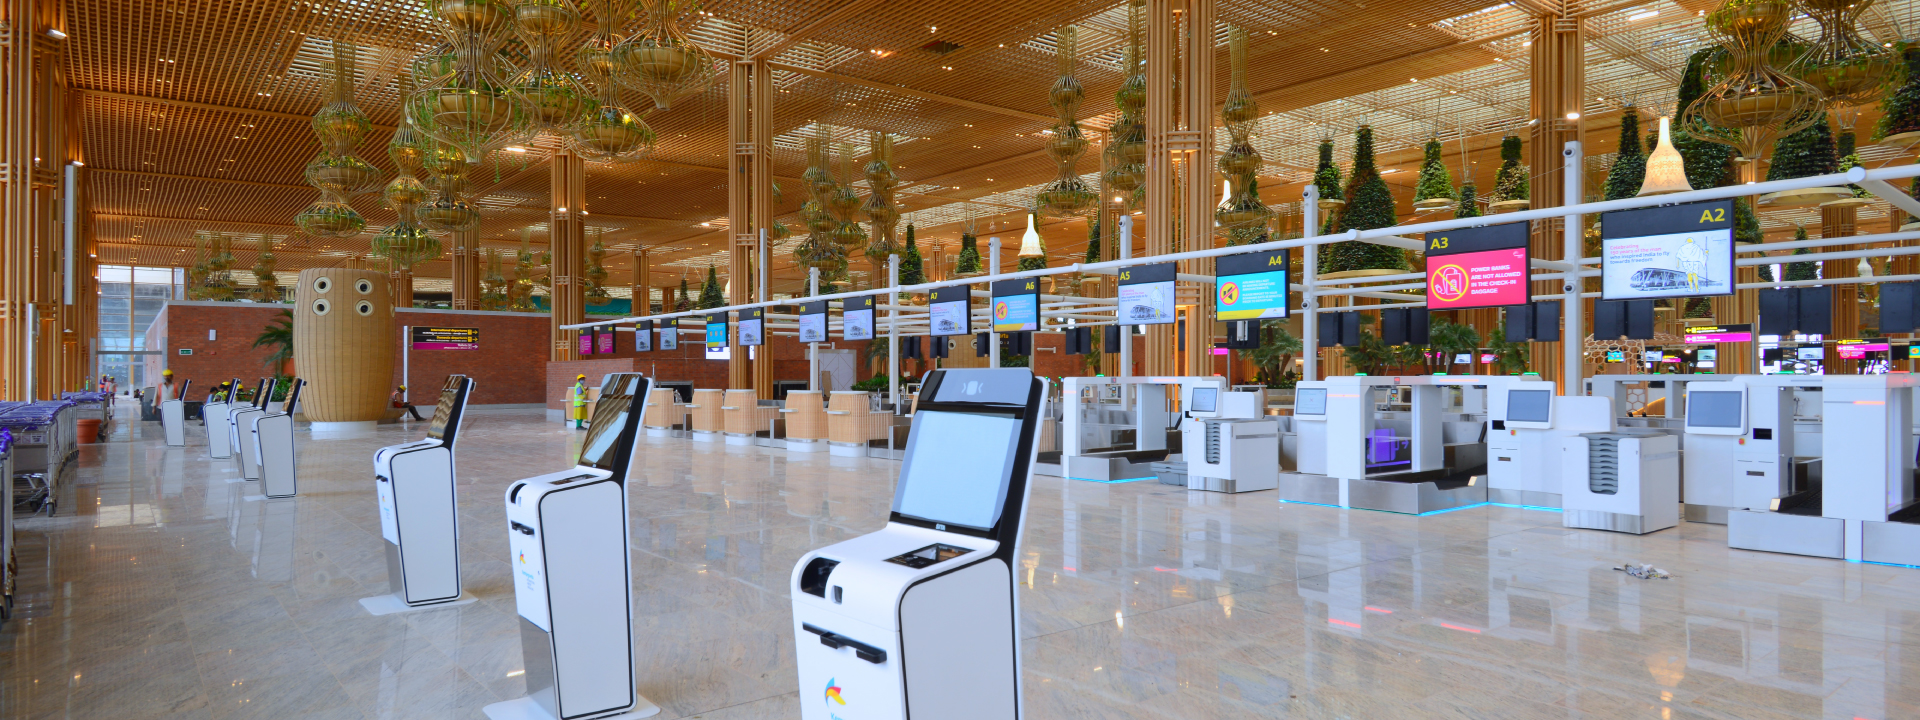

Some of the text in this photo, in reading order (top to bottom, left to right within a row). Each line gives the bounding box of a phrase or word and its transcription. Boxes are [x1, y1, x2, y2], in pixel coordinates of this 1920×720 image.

[1699, 208, 1725, 223] A2
[1430, 237, 1449, 250] A3
[1268, 255, 1282, 266] A4
[1120, 271, 1130, 280] A5
[1025, 281, 1035, 290] A6
